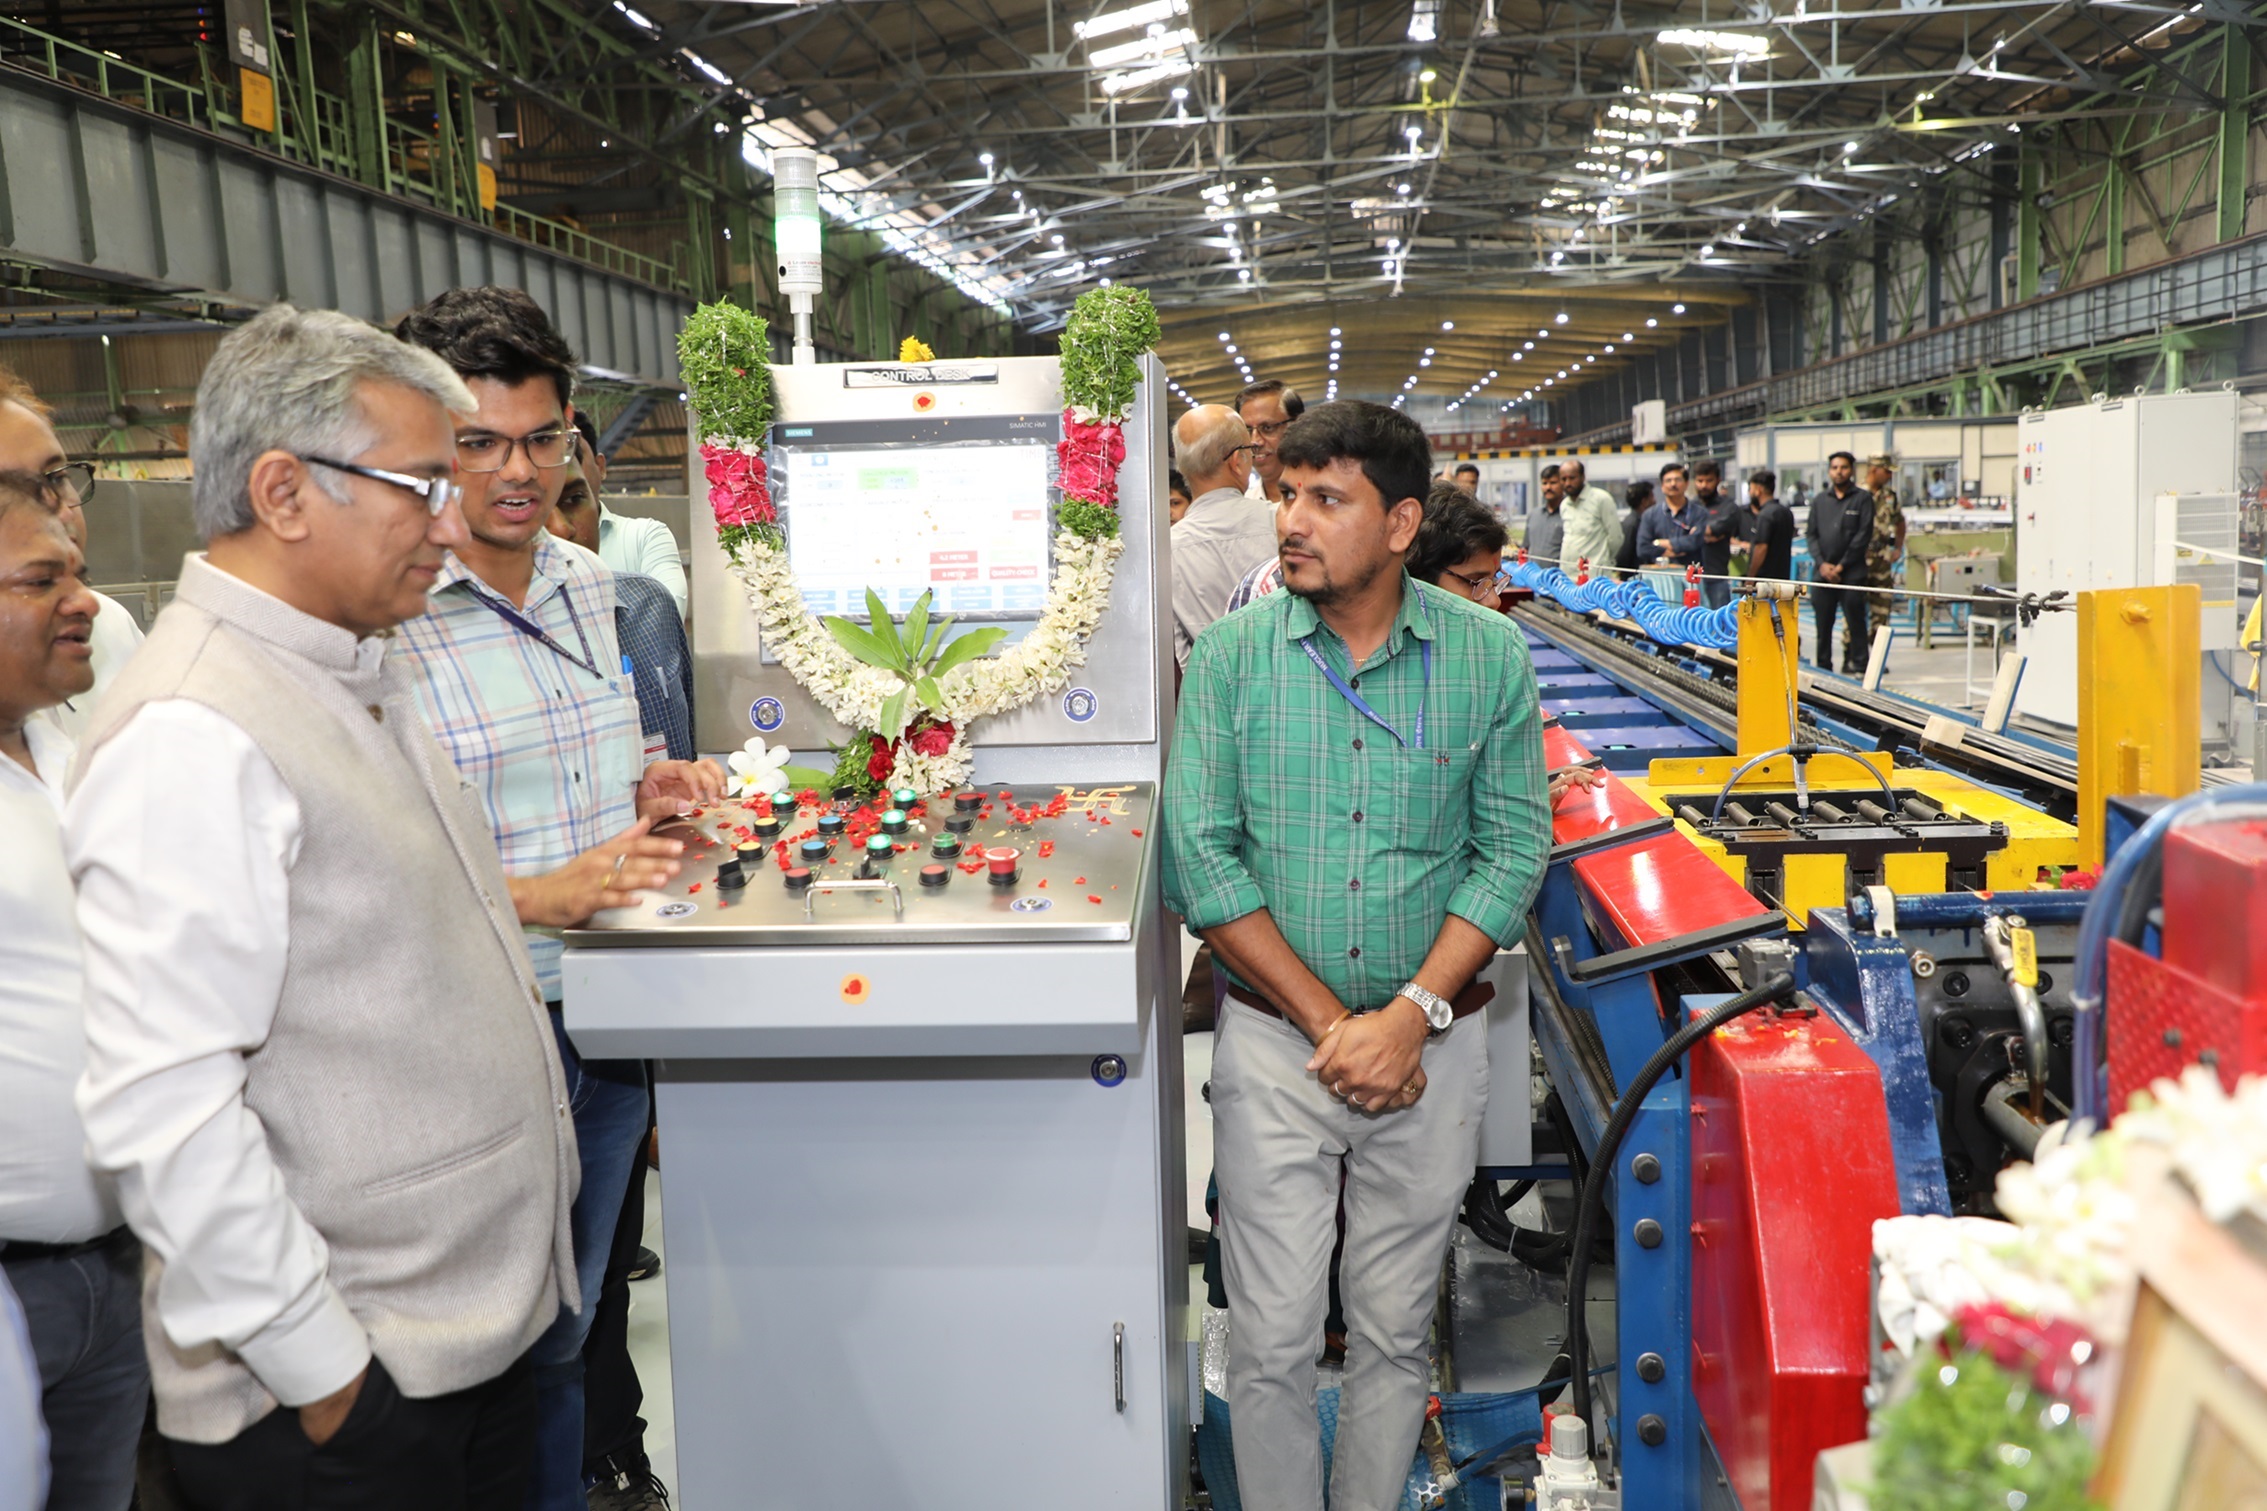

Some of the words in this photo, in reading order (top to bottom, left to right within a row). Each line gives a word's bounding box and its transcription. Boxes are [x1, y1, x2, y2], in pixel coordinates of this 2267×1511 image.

[872, 371, 932, 382] CONTROL
[936, 369, 971, 380] DESK
[1304, 643, 1328, 671] NUCLEAR
